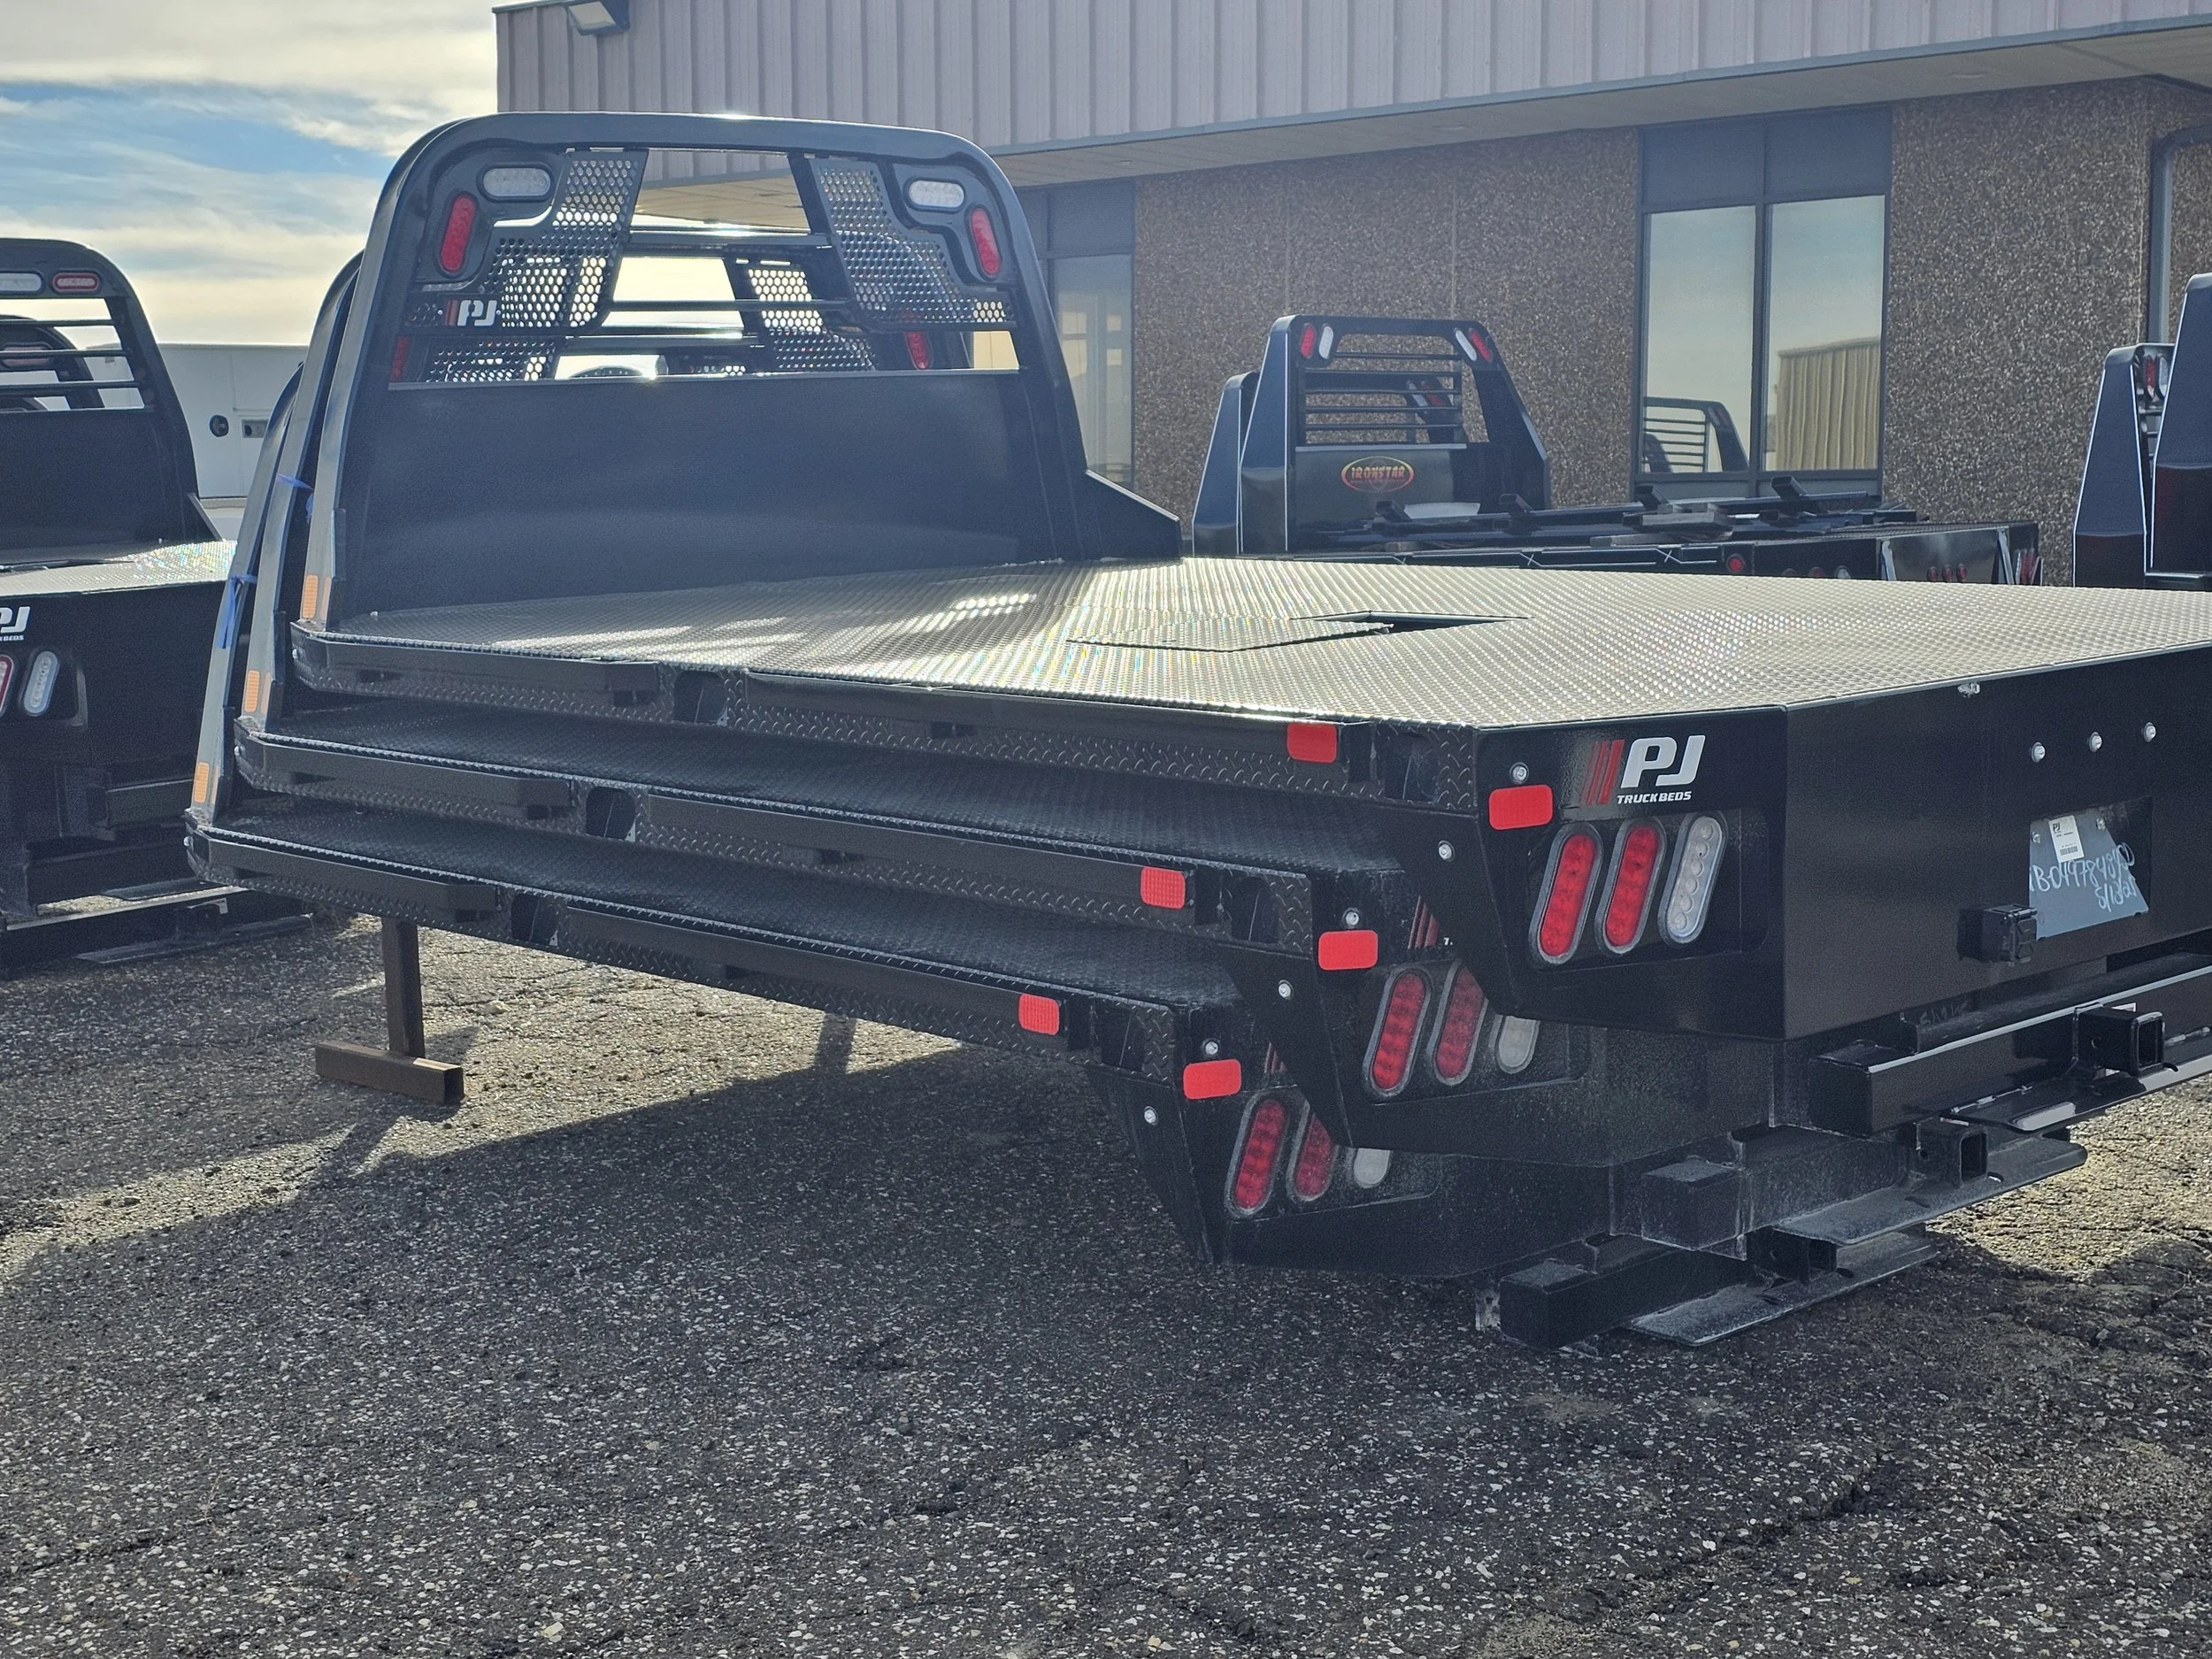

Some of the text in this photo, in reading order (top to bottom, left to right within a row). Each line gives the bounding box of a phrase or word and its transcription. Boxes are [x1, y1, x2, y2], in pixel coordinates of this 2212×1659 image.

[457, 299, 498, 326] PJ
[1621, 734, 1706, 788] PJ
[2053, 822, 2061, 832] PJ
